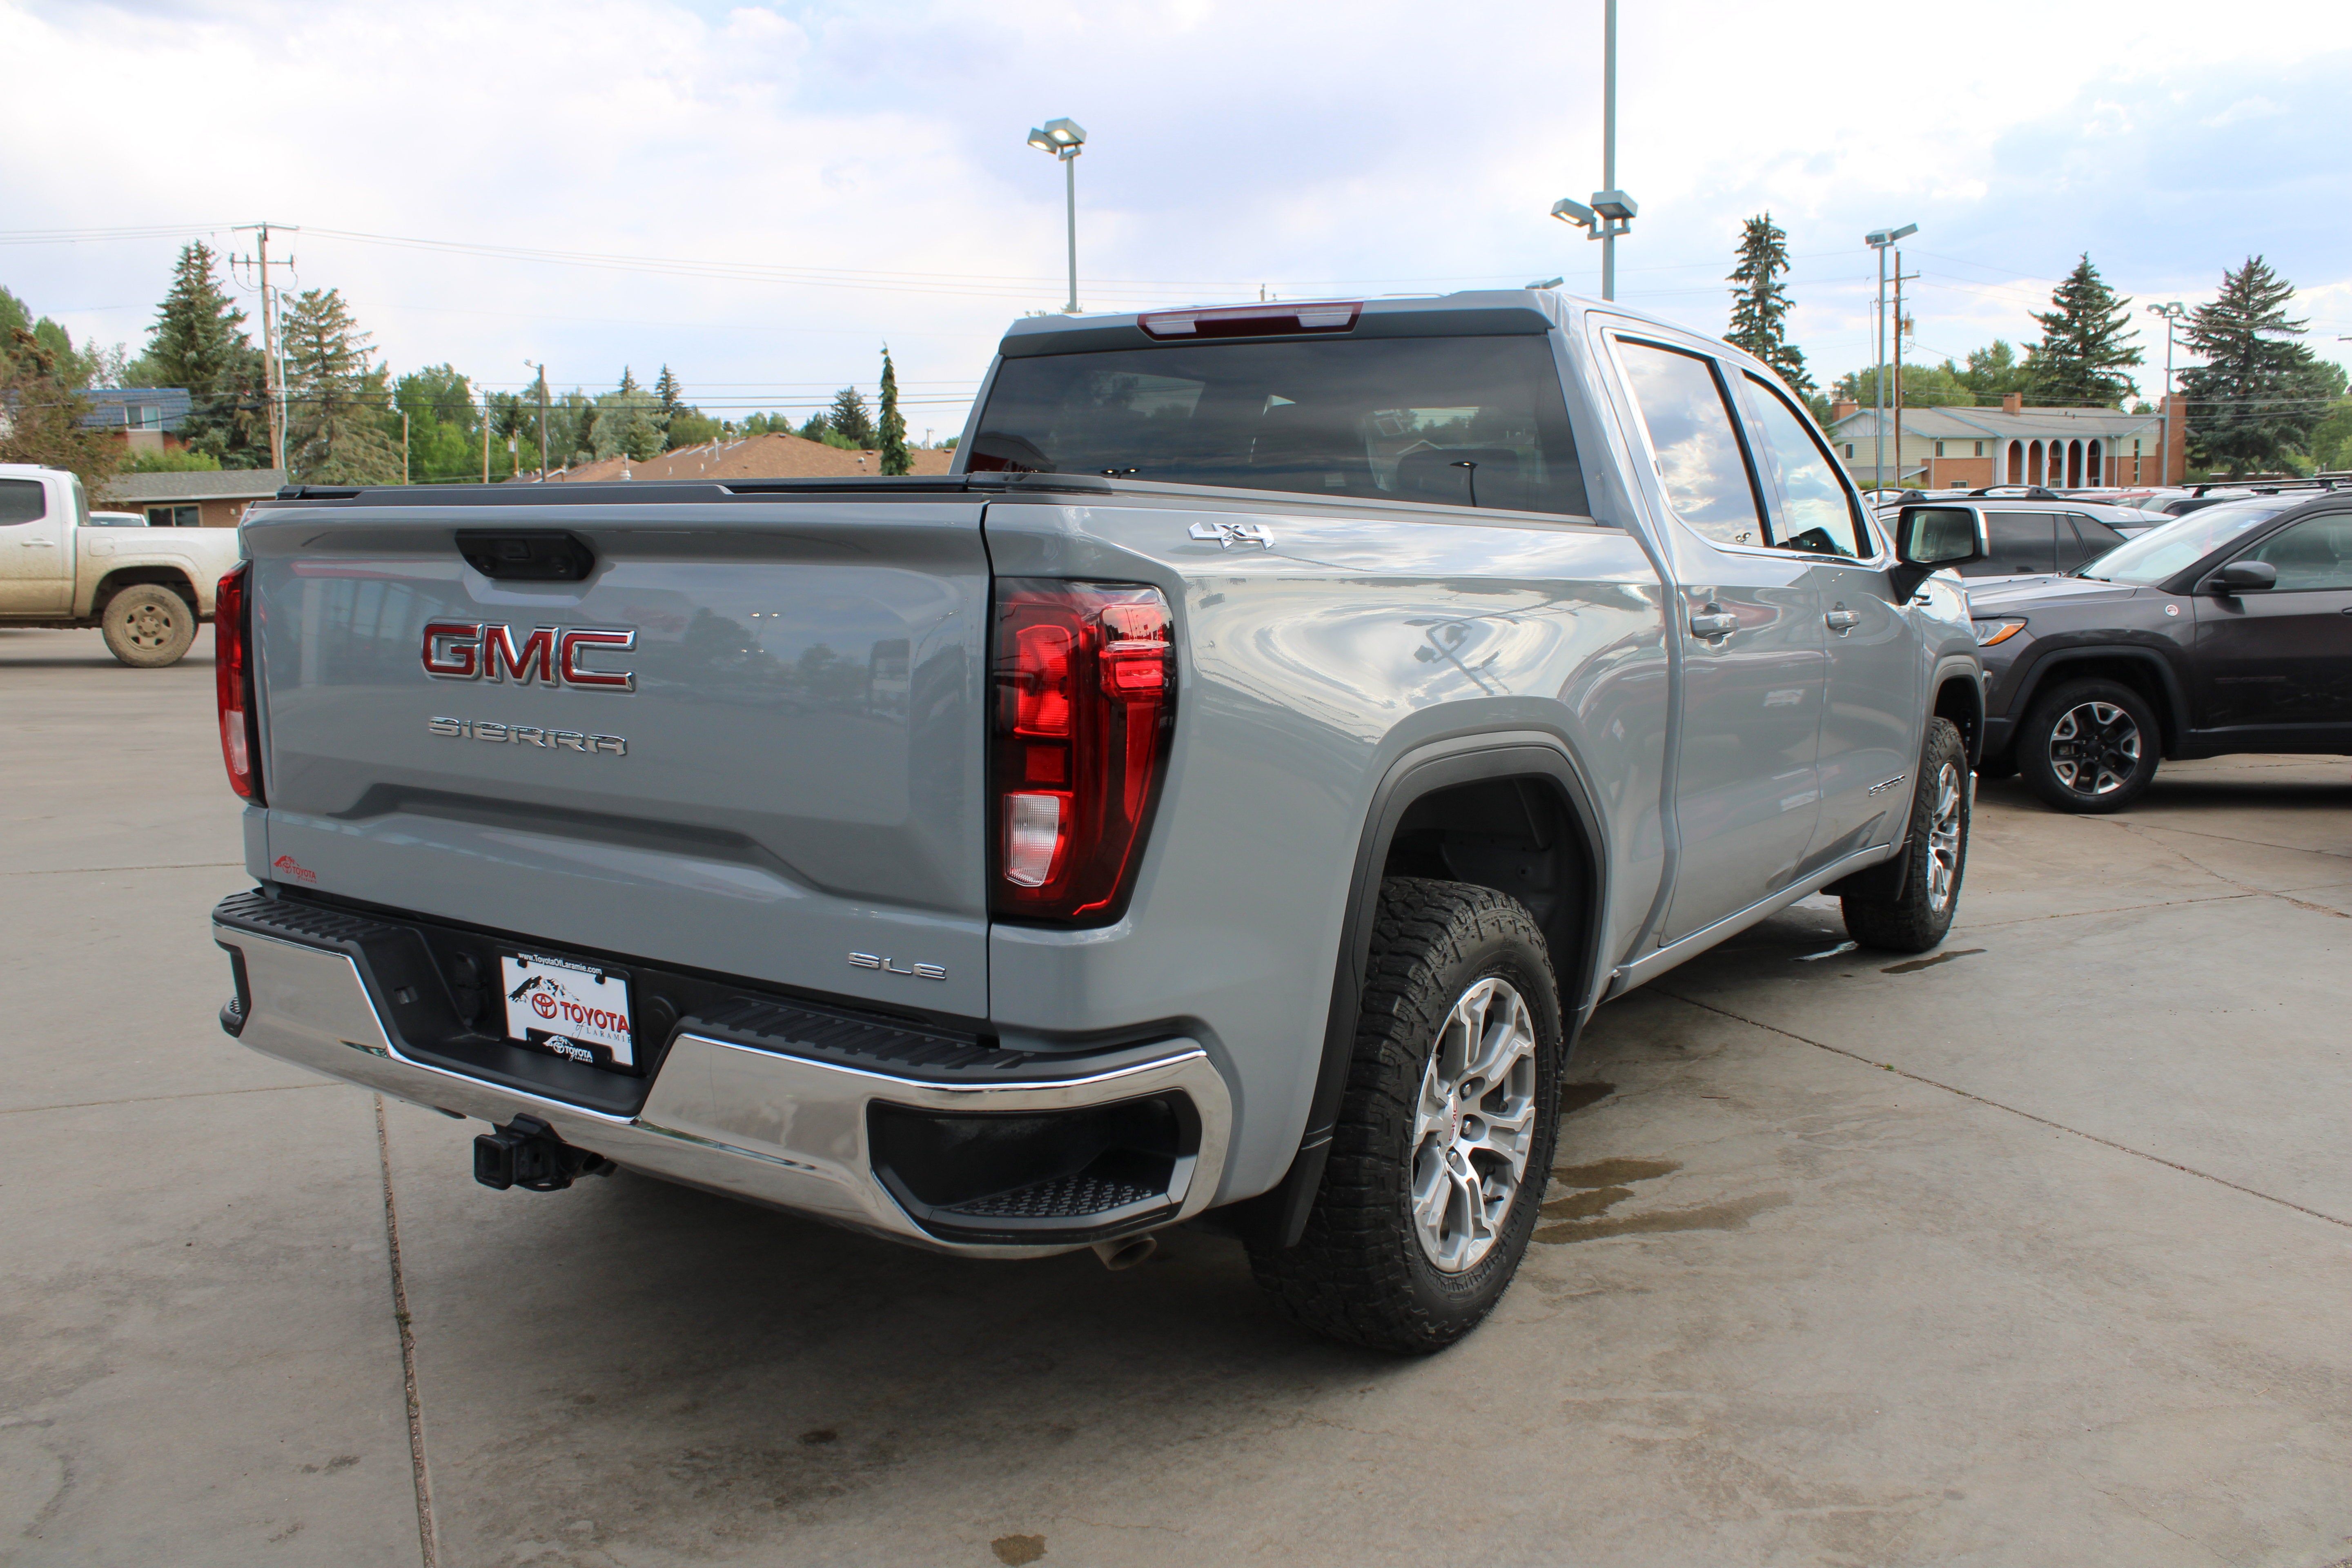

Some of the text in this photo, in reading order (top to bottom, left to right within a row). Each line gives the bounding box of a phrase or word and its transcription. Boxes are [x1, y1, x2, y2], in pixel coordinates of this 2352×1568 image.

[422, 622, 636, 692] GMC
[429, 717, 627, 755] SIERRA
[292, 866, 316, 879] TOYOTA
[518, 953, 602, 975] www.ToyotaOfLaramie.com
[849, 951, 946, 980] SLE
[560, 1001, 631, 1034] TOYOTA
[564, 1045, 593, 1059] TOYOTA
[1448, 1100, 1457, 1141] GMC
